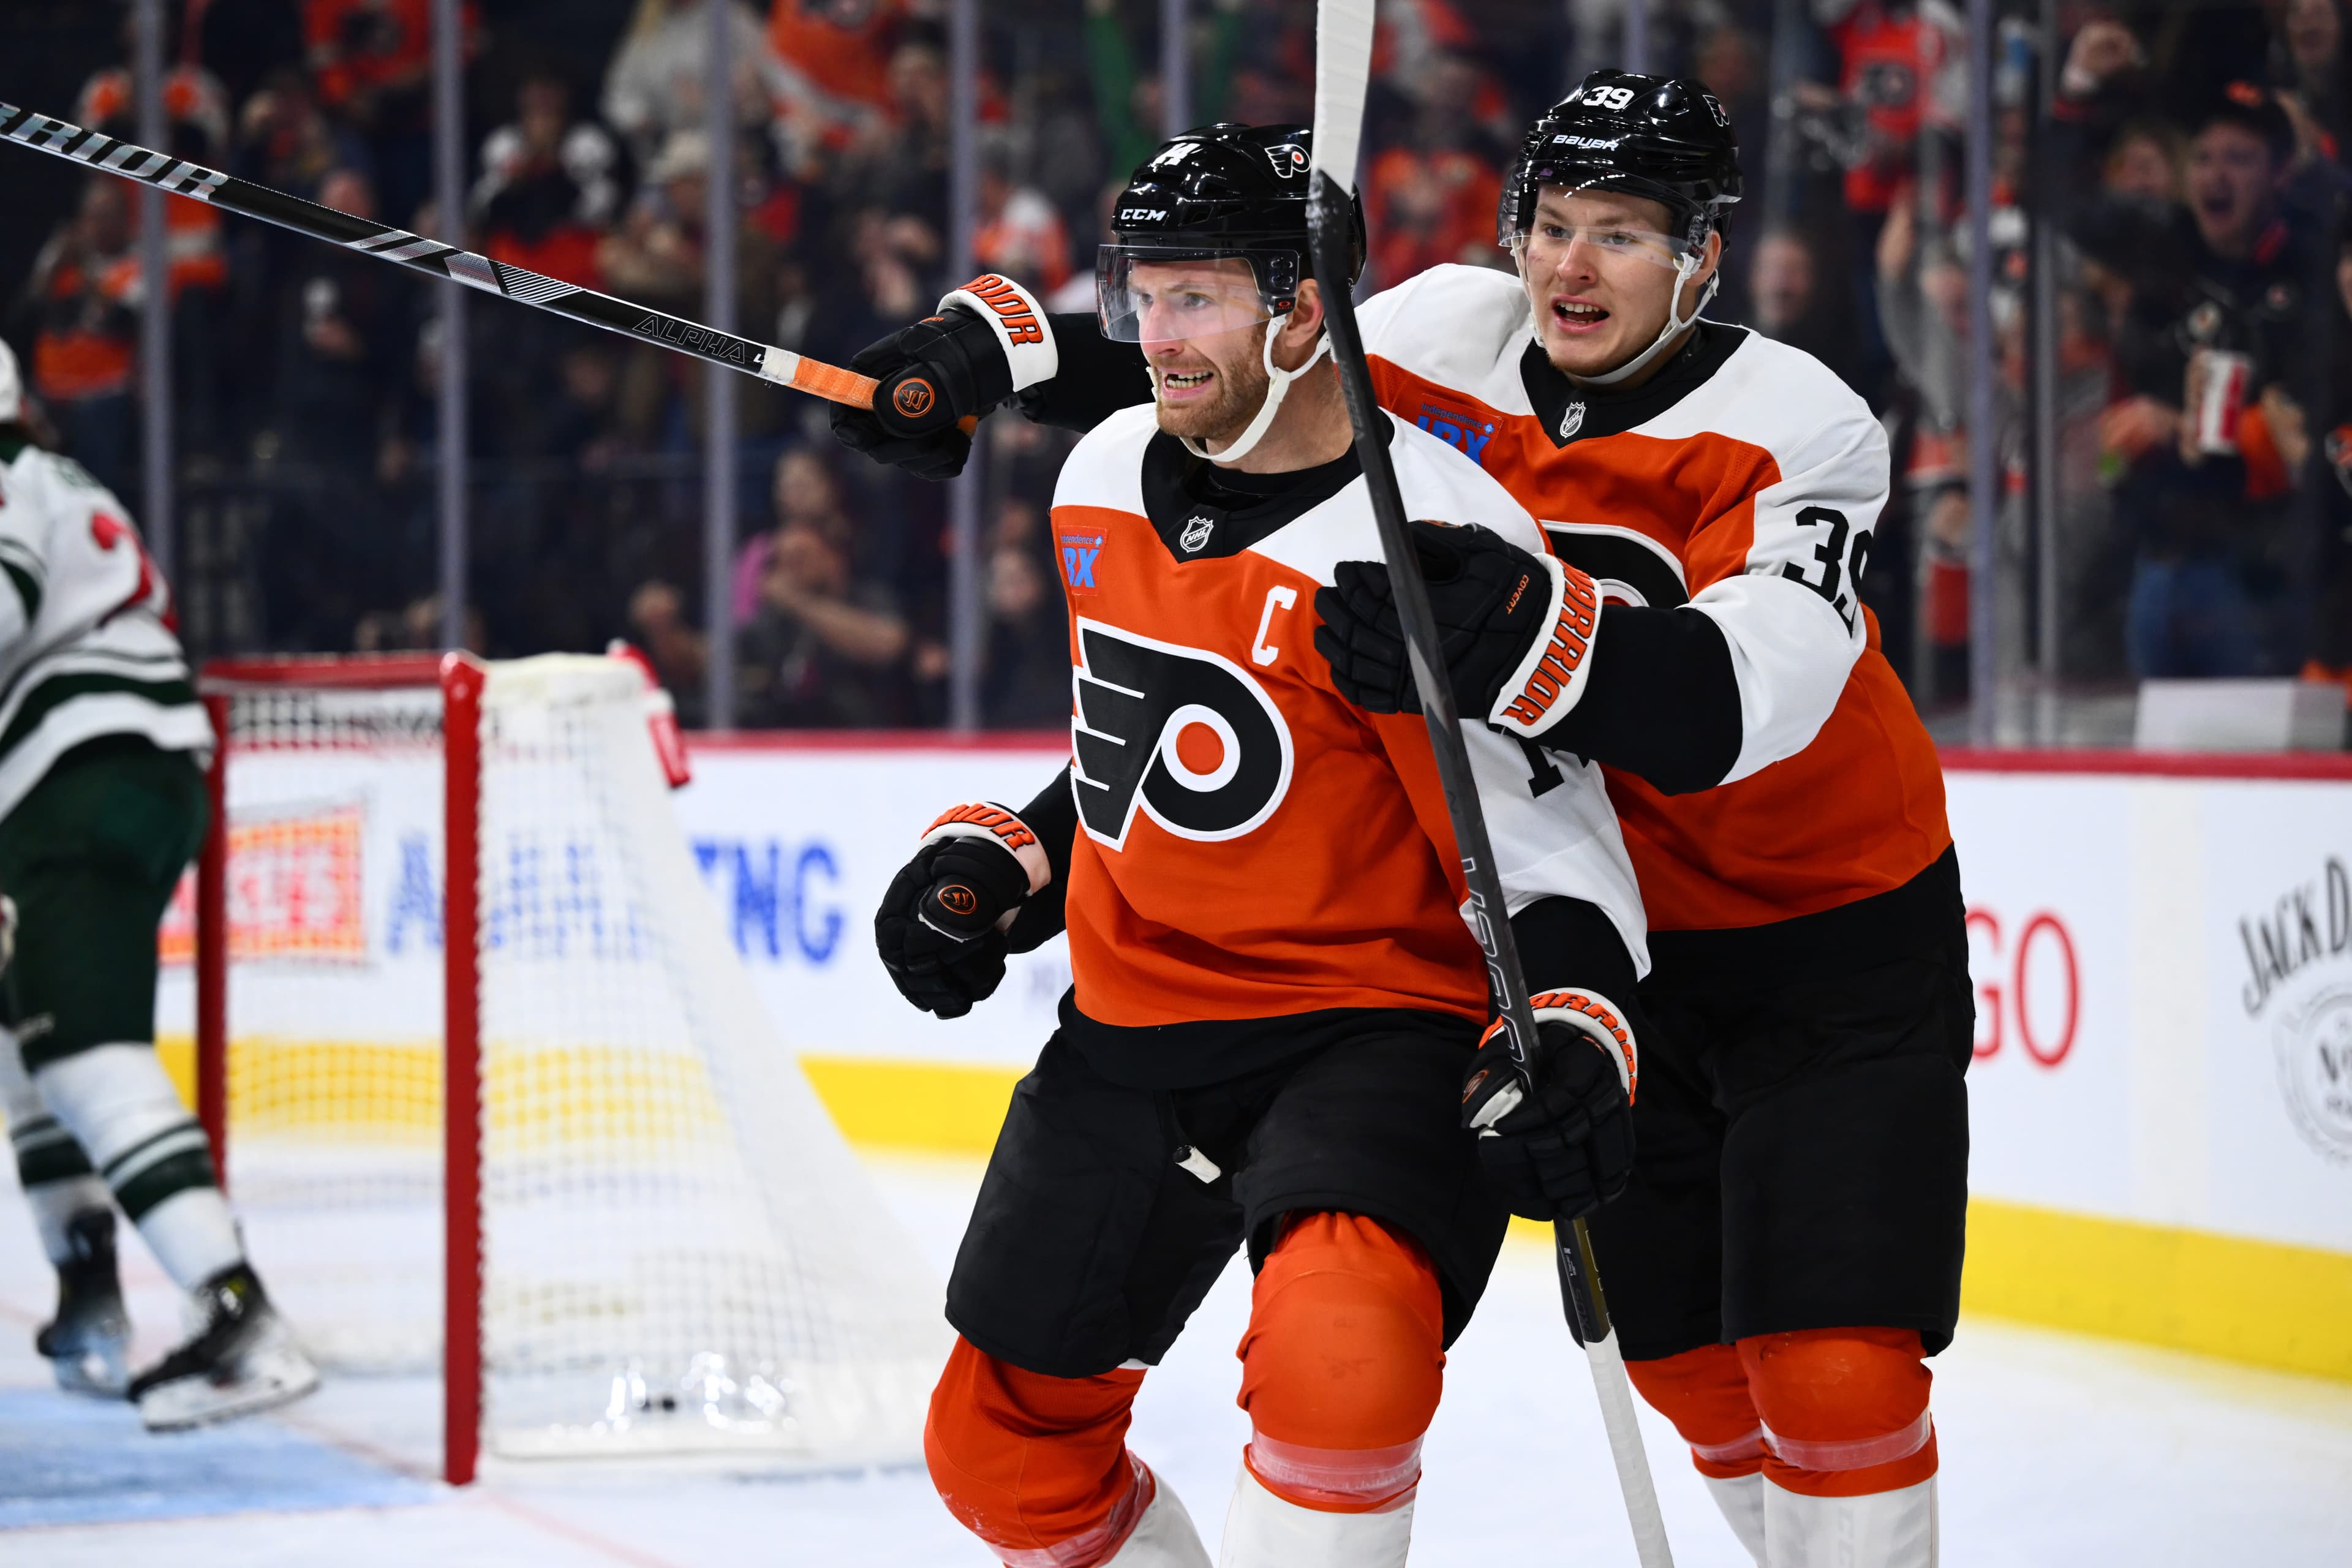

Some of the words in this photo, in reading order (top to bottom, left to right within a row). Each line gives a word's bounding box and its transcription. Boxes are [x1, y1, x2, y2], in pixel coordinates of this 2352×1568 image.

[1582, 86, 1635, 110] 39
[1552, 135, 1619, 151] BAUER
[1121, 209, 1167, 221] CCM
[631, 315, 745, 364] ALPHA
[1421, 402, 1482, 429] Independence
[1566, 414, 1580, 429] NHL
[1185, 527, 1208, 543] NHL
[1506, 575, 1529, 615] COVERT
[1251, 585, 1297, 666] C
